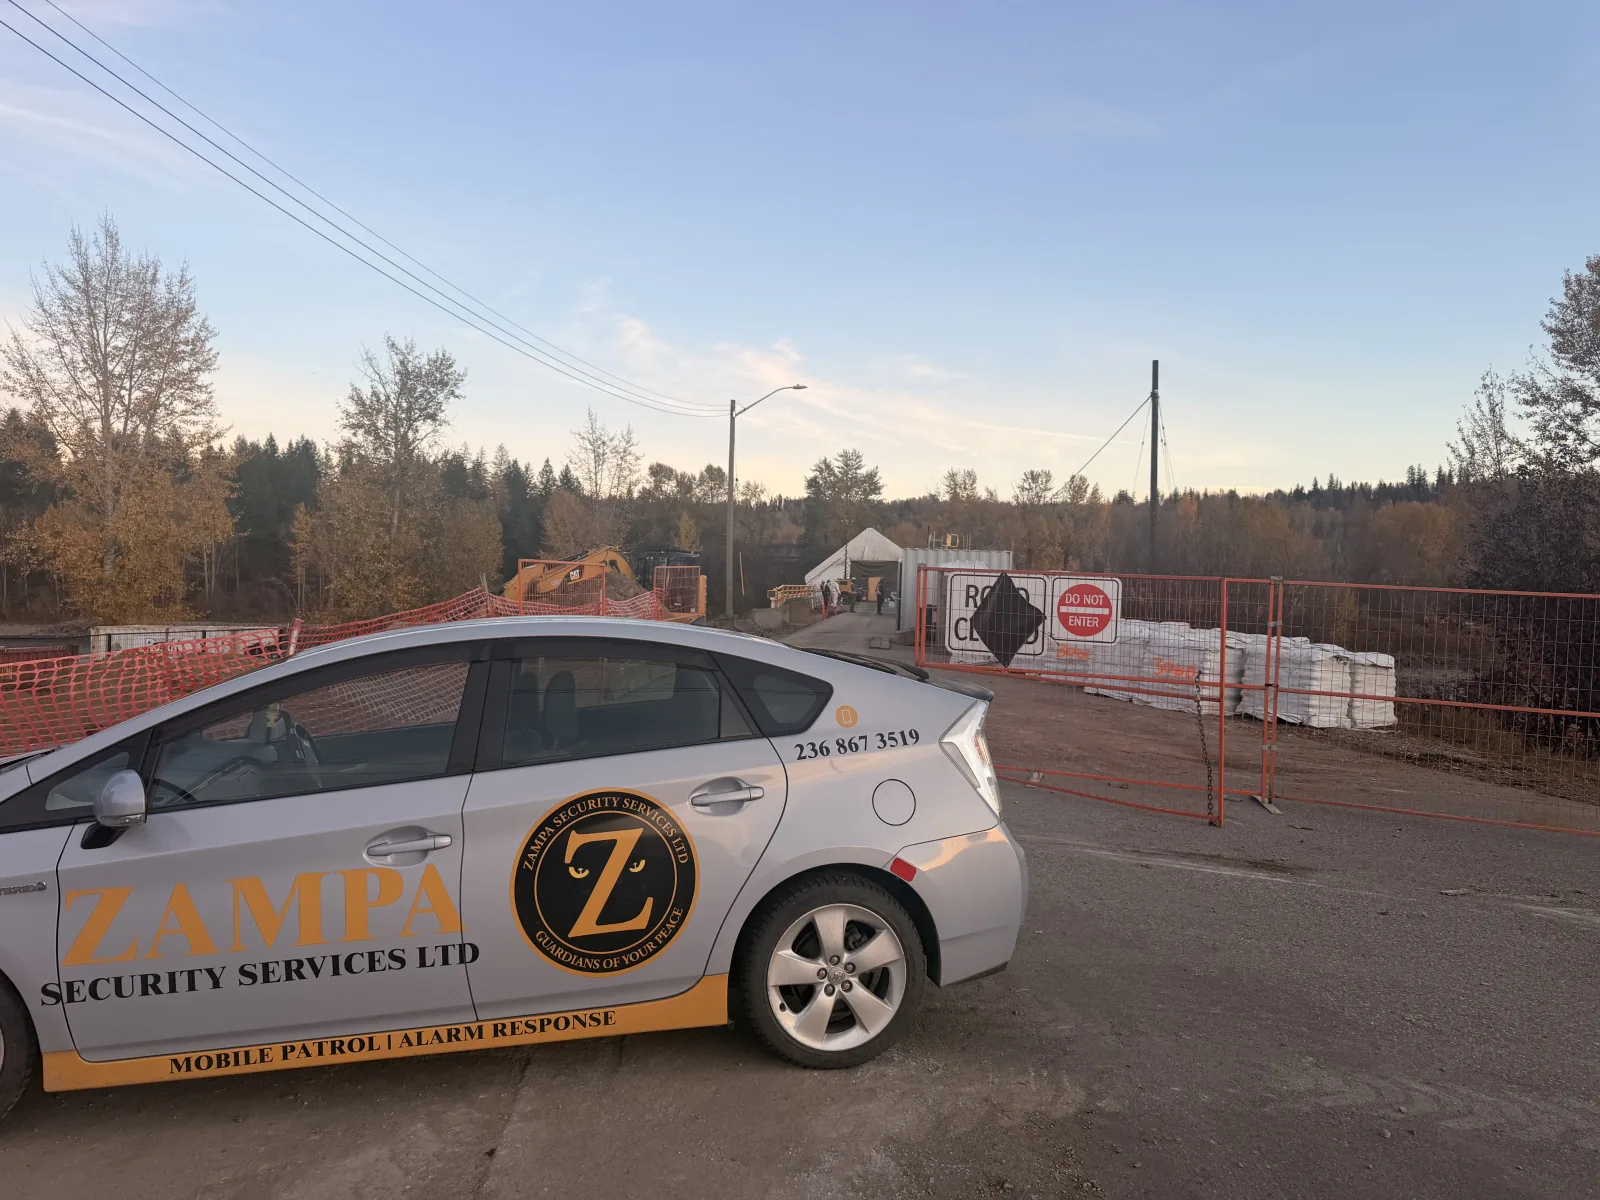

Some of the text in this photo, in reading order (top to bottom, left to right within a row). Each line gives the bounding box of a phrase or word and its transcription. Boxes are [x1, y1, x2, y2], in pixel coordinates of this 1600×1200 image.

[569, 569, 580, 580] CAT
[1065, 593, 1105, 606] DO NOT
[1068, 616, 1099, 628] ENTER
[794, 728, 920, 761] 236 867 3519
[522, 796, 689, 871] ZAMPA SECURITY SERVICES LTD
[564, 827, 654, 938] Z
[61, 863, 468, 966] ZAMPA
[535, 907, 684, 970] GUARDIANS OF YOUR PEACE
[40, 942, 480, 1006] SECURITY SERVICES LTD
[169, 1047, 274, 1074] MOBILE
[281, 1036, 381, 1061] PATROL
[399, 1024, 486, 1049] ALARM
[492, 1010, 617, 1039] RESPONSE
